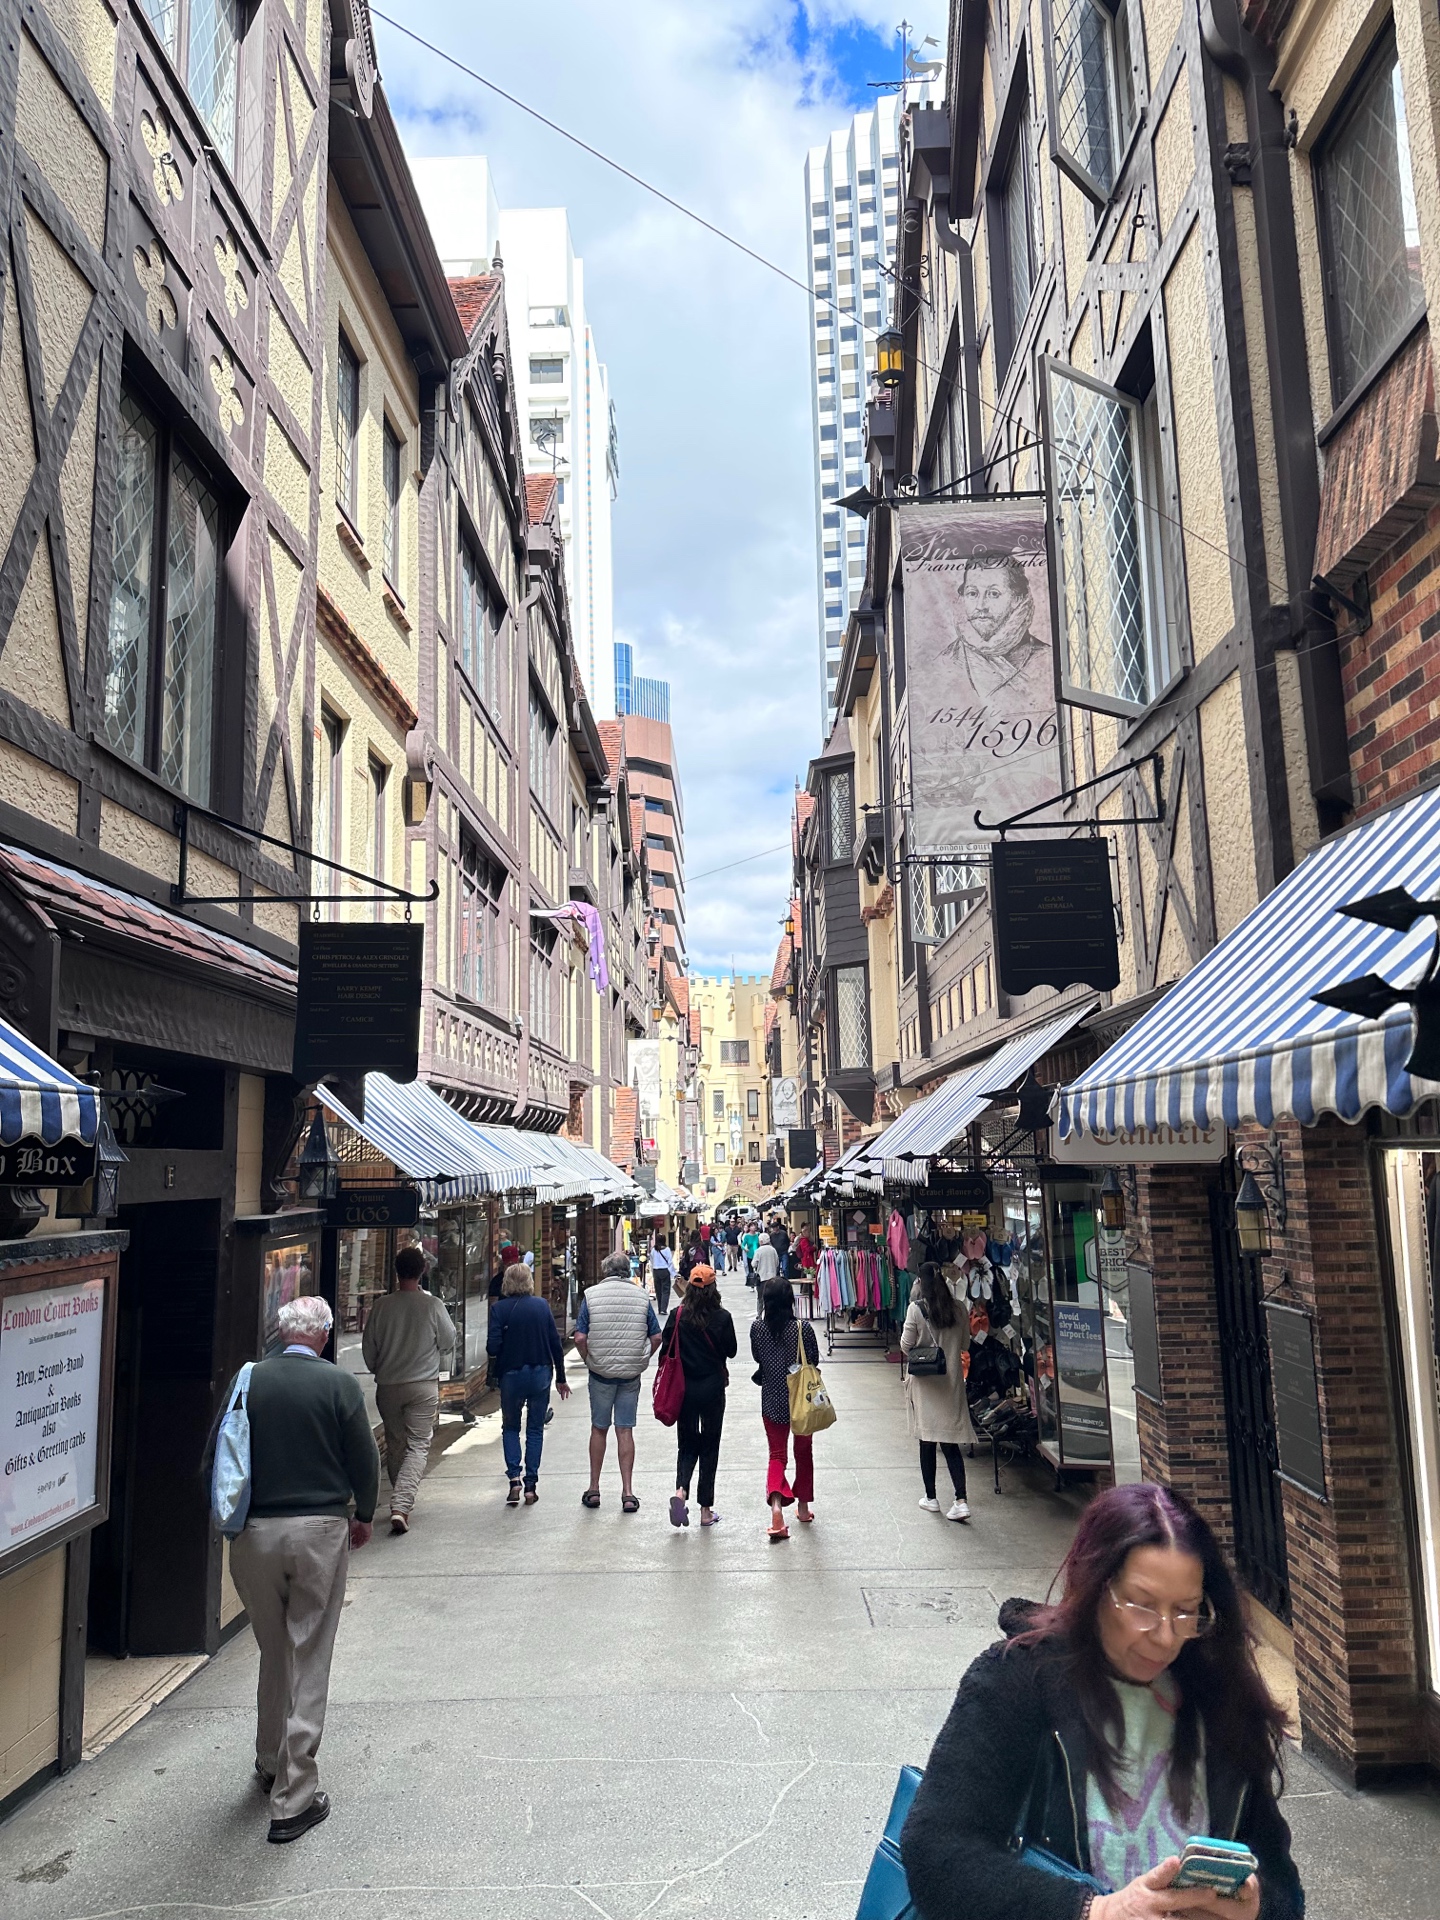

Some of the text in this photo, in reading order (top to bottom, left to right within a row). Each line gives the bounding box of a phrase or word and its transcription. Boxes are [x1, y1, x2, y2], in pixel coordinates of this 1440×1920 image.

[901, 530, 959, 561] Sir
[906, 551, 1048, 573] Francis Drake
[930, 705, 988, 728] 1544
[965, 712, 1058, 758] 1596
[932, 842, 991, 852] London Court
[1036, 875, 1071, 883] JEWELLERS
[1037, 902, 1074, 910] AUSTRALIA
[16, 1148, 77, 1177] Box
[350, 1193, 385, 1203] Genuine
[919, 1188, 944, 1196] Travel
[946, 1188, 971, 1197] Money
[345, 1206, 390, 1223] UGG
[1100, 1247, 1126, 1256] BEST
[3, 1292, 99, 1331] London Court Books
[1058, 1311, 1079, 1321] Avoid
[1059, 1320, 1091, 1331] sky high
[1059, 1329, 1102, 1341] airport fees
[16, 1353, 85, 1388] New, Second-Hand
[47, 1384, 55, 1397] &
[15, 1391, 82, 1428] Antiquarian Books
[41, 1420, 56, 1438] also
[5, 1430, 86, 1476] Gifts & Greeting cards
